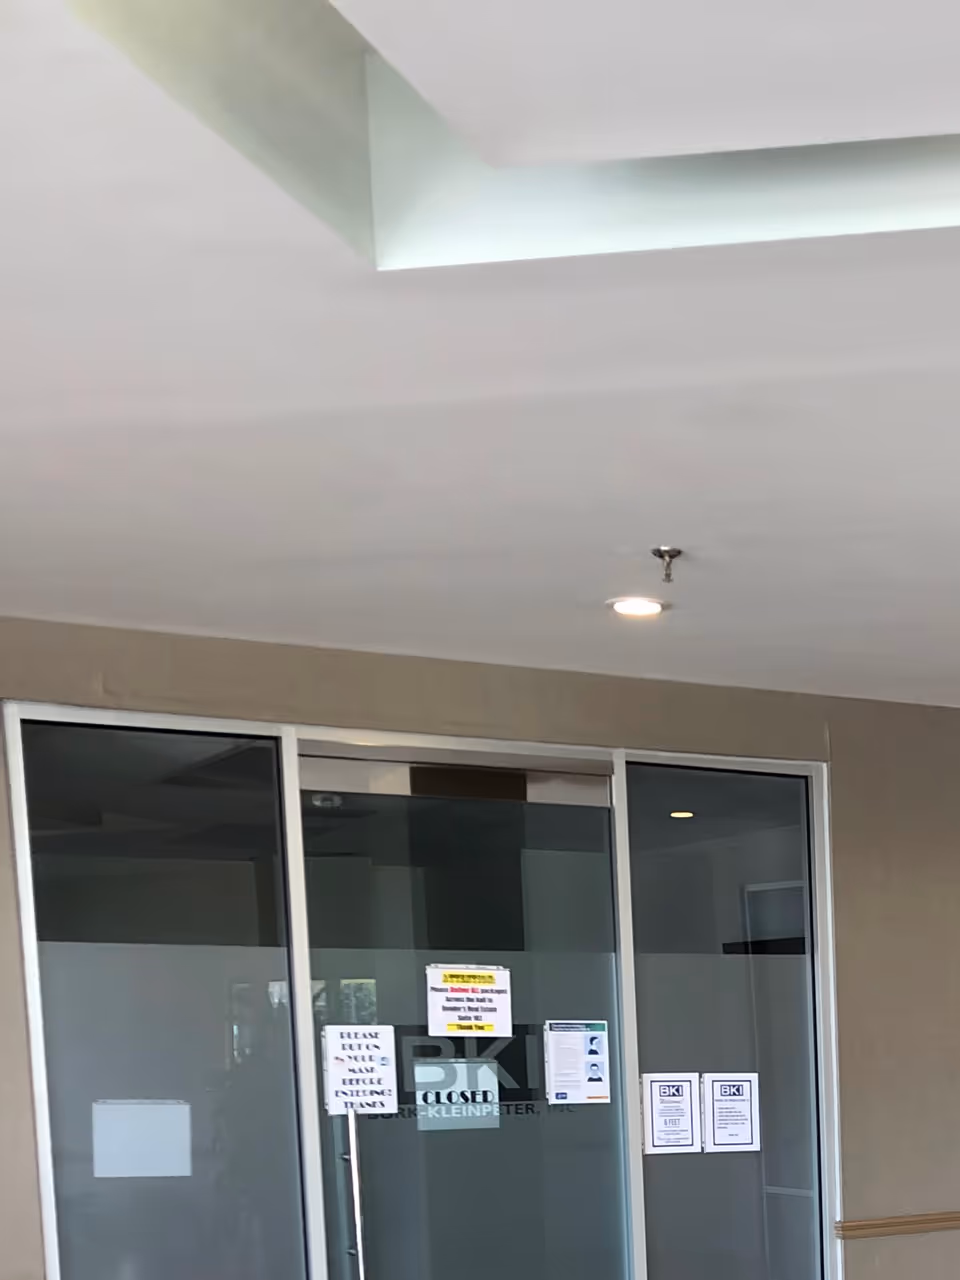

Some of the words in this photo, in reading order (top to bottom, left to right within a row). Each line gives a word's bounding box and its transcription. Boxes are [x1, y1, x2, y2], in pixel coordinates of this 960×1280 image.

[340, 1031, 381, 1039] PLEASE
[341, 1043, 362, 1051] PUT
[366, 1043, 381, 1051] ON
[402, 1035, 540, 1092] BKI
[342, 1078, 383, 1086] BEFORE
[660, 1085, 683, 1096] BKI
[721, 1085, 743, 1096] BKI
[422, 1090, 494, 1105] CLOSED
[343, 1101, 386, 1109] THANKS
